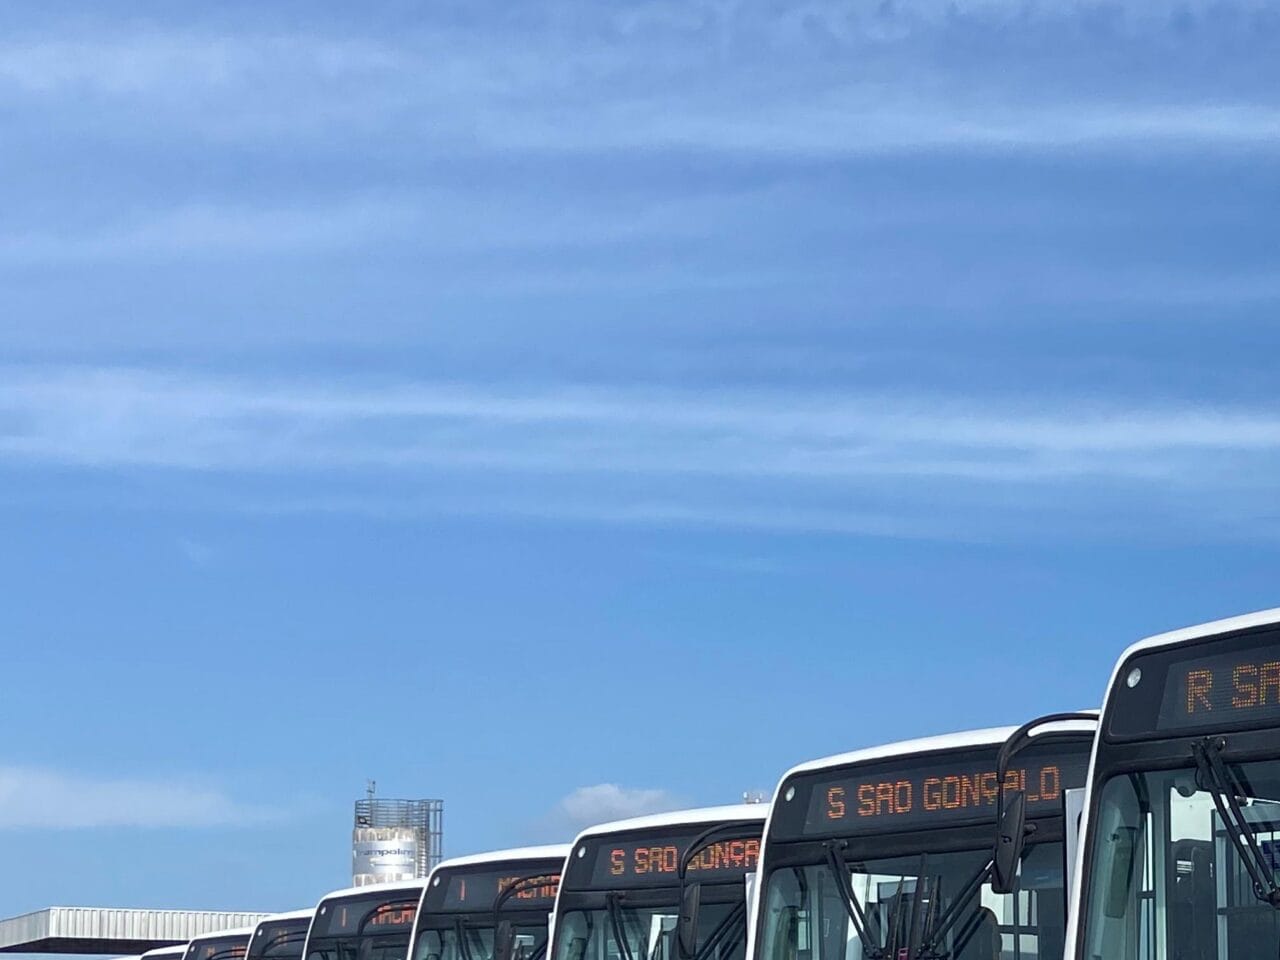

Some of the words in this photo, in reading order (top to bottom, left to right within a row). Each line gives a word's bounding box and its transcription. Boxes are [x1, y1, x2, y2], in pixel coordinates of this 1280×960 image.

[1186, 670, 1212, 713] R
[827, 787, 845, 819] S
[857, 780, 912, 816] SAO
[611, 848, 625, 875] S
[634, 846, 677, 874] SAO
